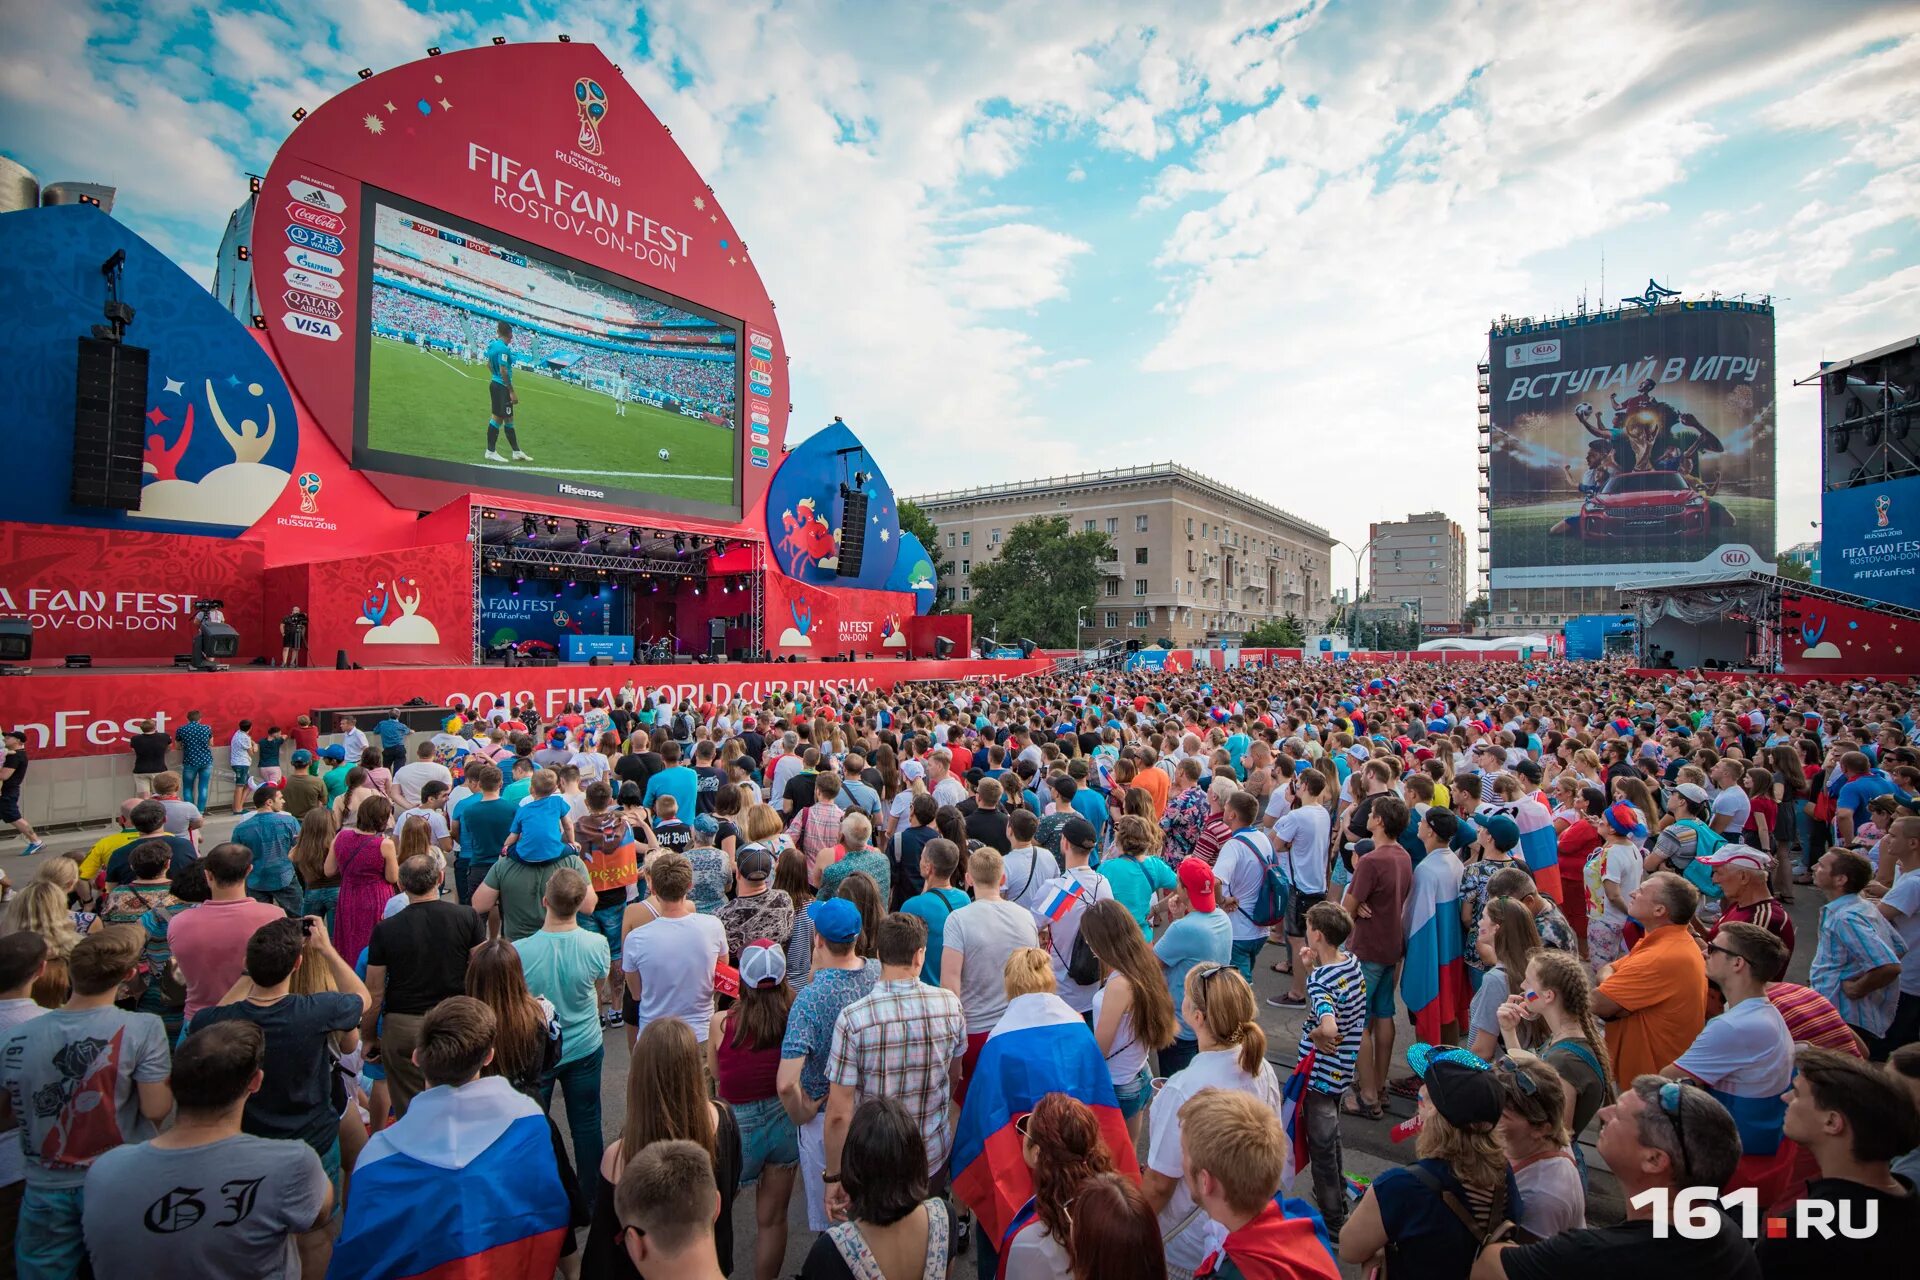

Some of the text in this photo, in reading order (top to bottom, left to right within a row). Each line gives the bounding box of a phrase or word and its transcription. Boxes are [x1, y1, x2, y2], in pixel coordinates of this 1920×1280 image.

[555, 150, 621, 187] RUSSIA 2018
[303, 196, 331, 209] adidas
[468, 142, 693, 257] FIFA FAN FEST
[494, 185, 676, 272] ROSTOV-ON-DON
[310, 242, 338, 254] WANDA
[504, 253, 525, 267] 21:46
[288, 291, 337, 312] QATAR
[300, 304, 337, 319] AIRWAYS
[292, 316, 332, 337] VISA
[1506, 355, 1760, 402] ВСТУПАЙ В ИГРУ
[558, 484, 604, 498] Hisense
[277, 517, 337, 531] RUSSIA 2018
[1864, 531, 1887, 540] RUSSIA
[1887, 529, 1903, 538] 2018
[1725, 553, 1745, 562] KIA
[1842, 546, 1867, 559] FIFA
[1869, 543, 1894, 556] FAN
[1849, 551, 1920, 566] ROSTOV-ON-DON
[1853, 567, 1916, 579] #FIFAFanFest
[29, 588, 106, 612] FAN
[116, 592, 198, 614] FEST
[489, 598, 520, 611] FAN
[523, 599, 557, 612] FEST
[482, 611, 532, 620] #FIFAFanFest
[850, 621, 874, 633] FEST
[656, 831, 691, 846] Pit Bull
